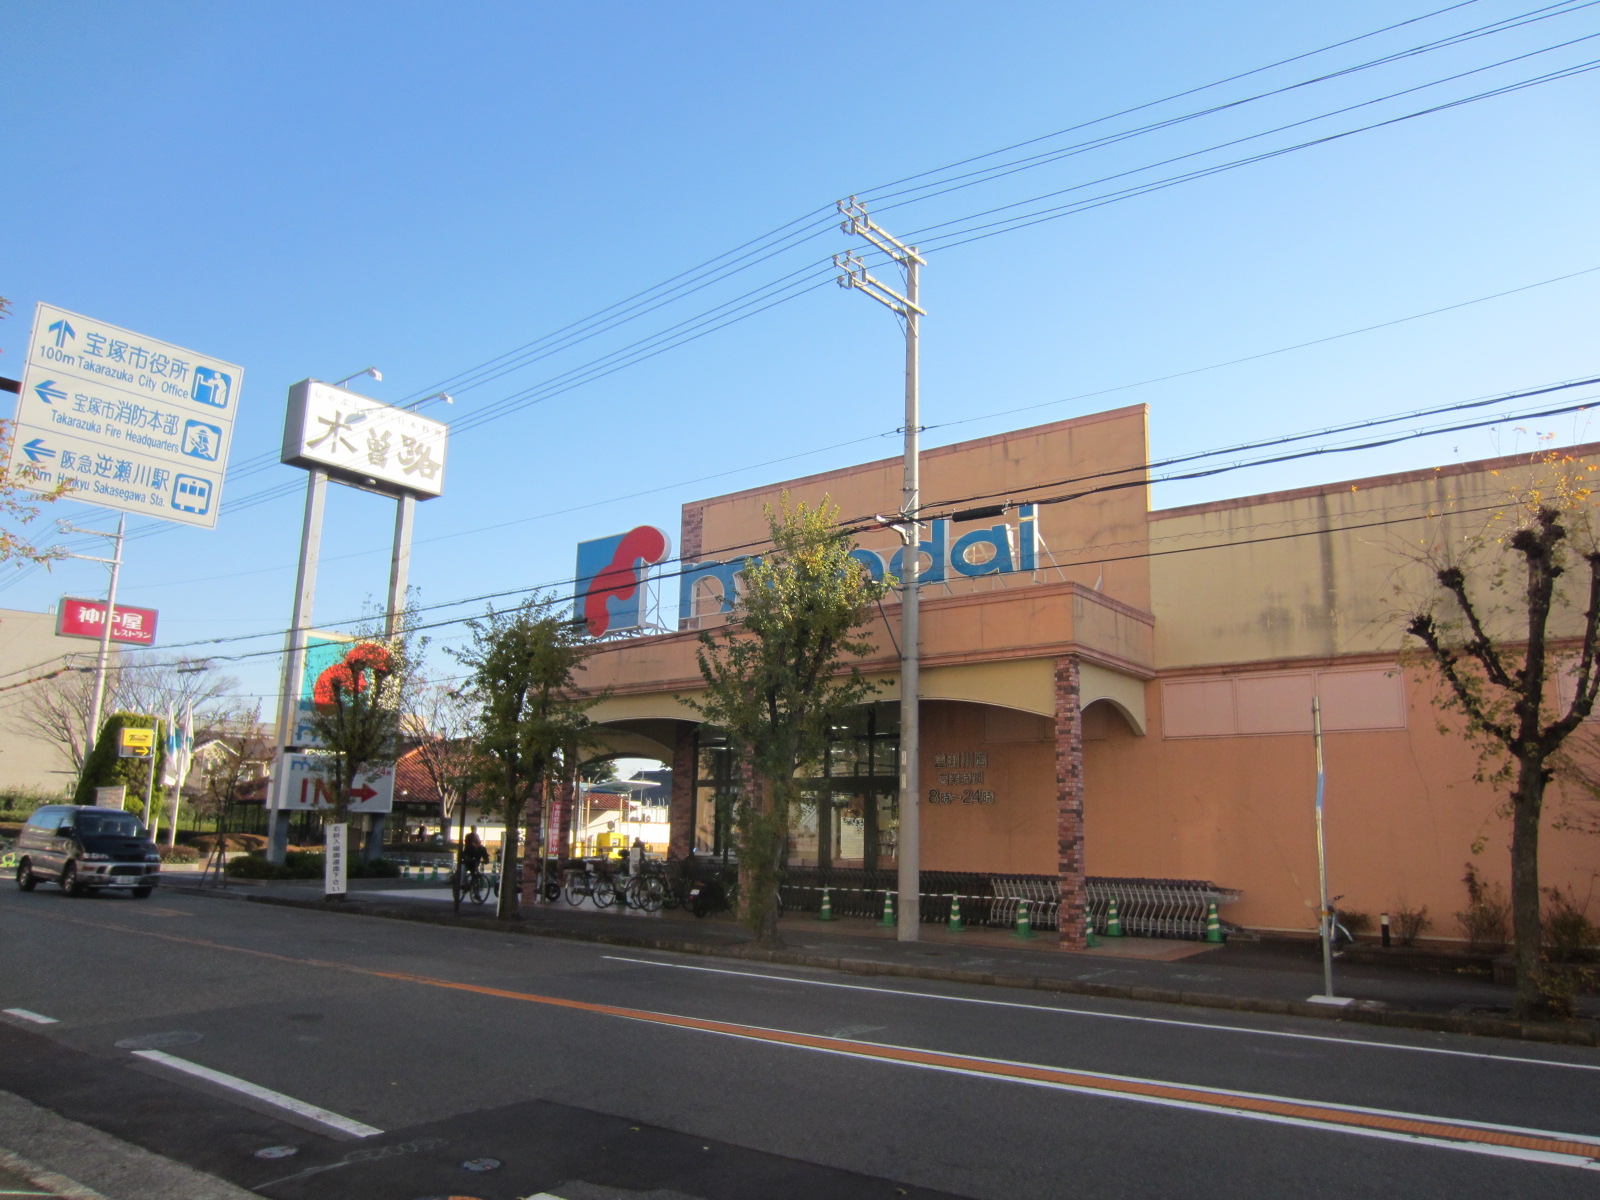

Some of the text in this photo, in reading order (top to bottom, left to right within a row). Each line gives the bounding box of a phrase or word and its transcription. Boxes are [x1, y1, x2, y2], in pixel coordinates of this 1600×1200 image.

[40, 345, 189, 399] 100m Takarazuka City Office
[83, 331, 190, 383] 宝塚市役所
[51, 410, 179, 454] Takarazuka Fire Headquarters
[72, 393, 180, 437] 宝塚市消防本部
[60, 449, 171, 492] 阪急逆瀬川駅
[93, 481, 146, 503] Sakasegawa
[150, 493, 165, 507] Sta.
[679, 503, 1038, 618] mndai
[113, 628, 152, 639] レストラン
